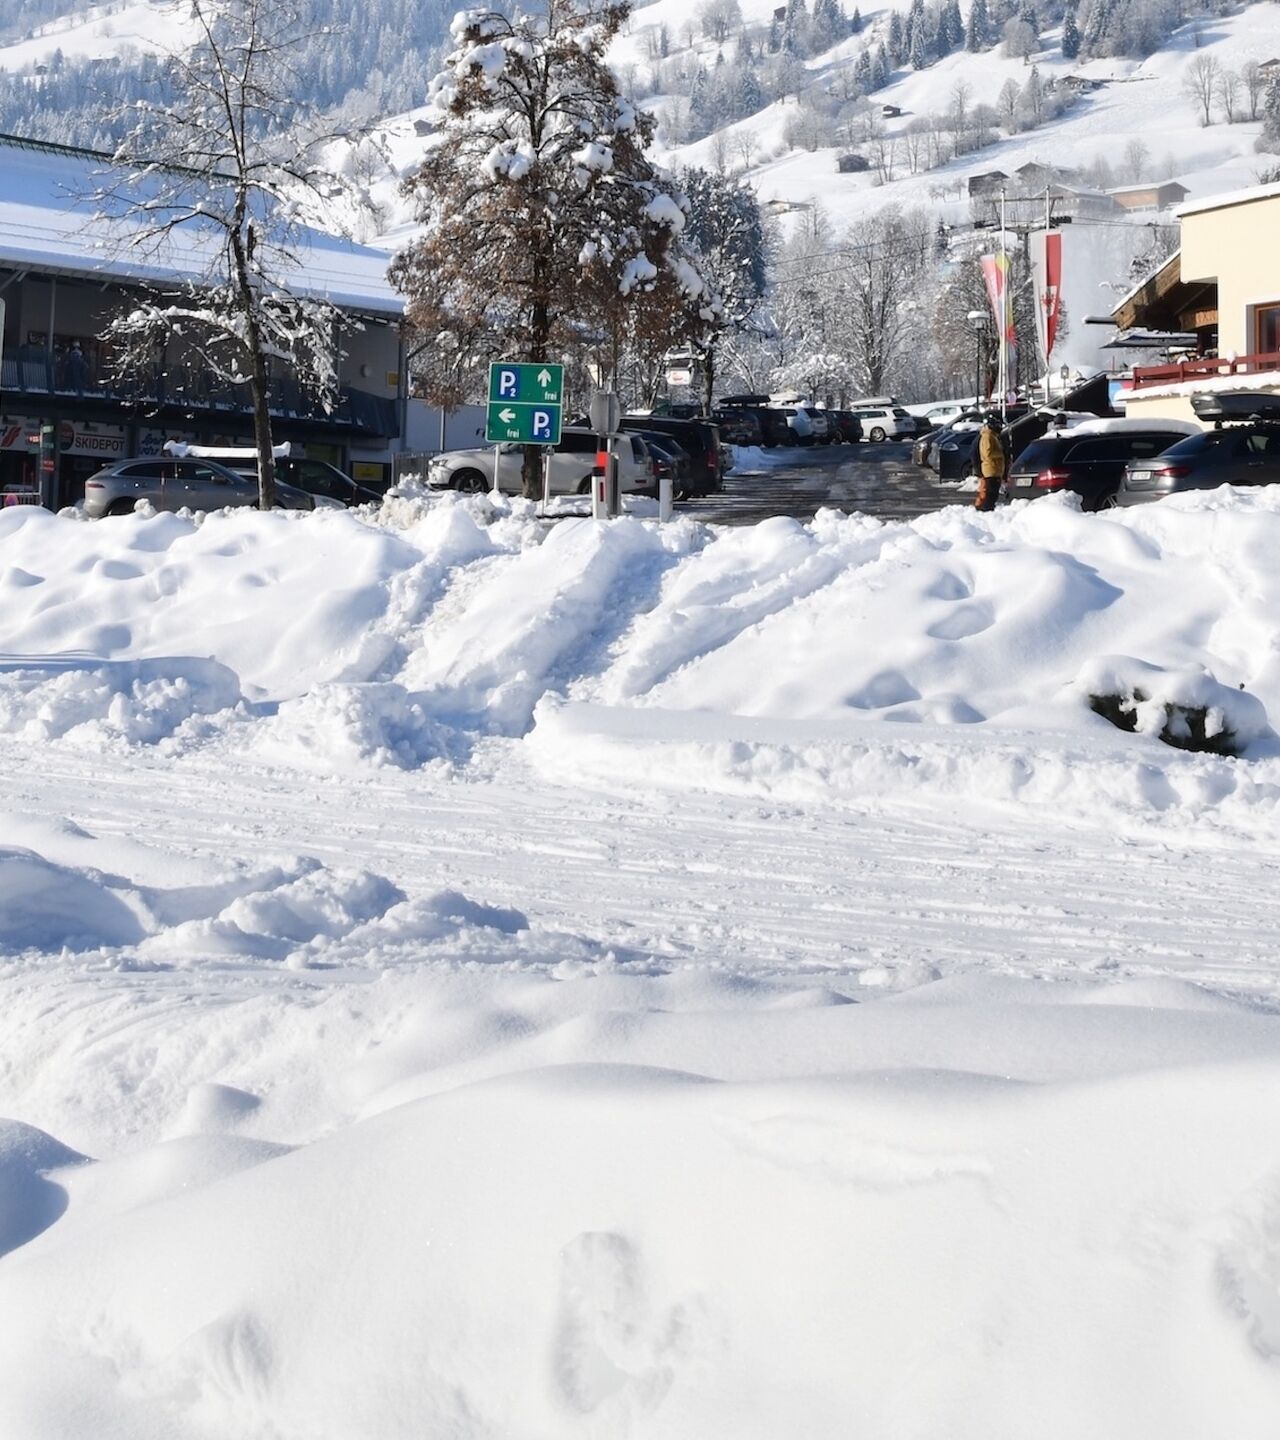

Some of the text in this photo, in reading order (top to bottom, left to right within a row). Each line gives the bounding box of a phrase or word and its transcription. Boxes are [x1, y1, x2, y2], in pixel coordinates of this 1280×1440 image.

[544, 391, 557, 400] frei
[506, 428, 519, 438] frei
[75, 437, 124, 452] SKIDEPOT
